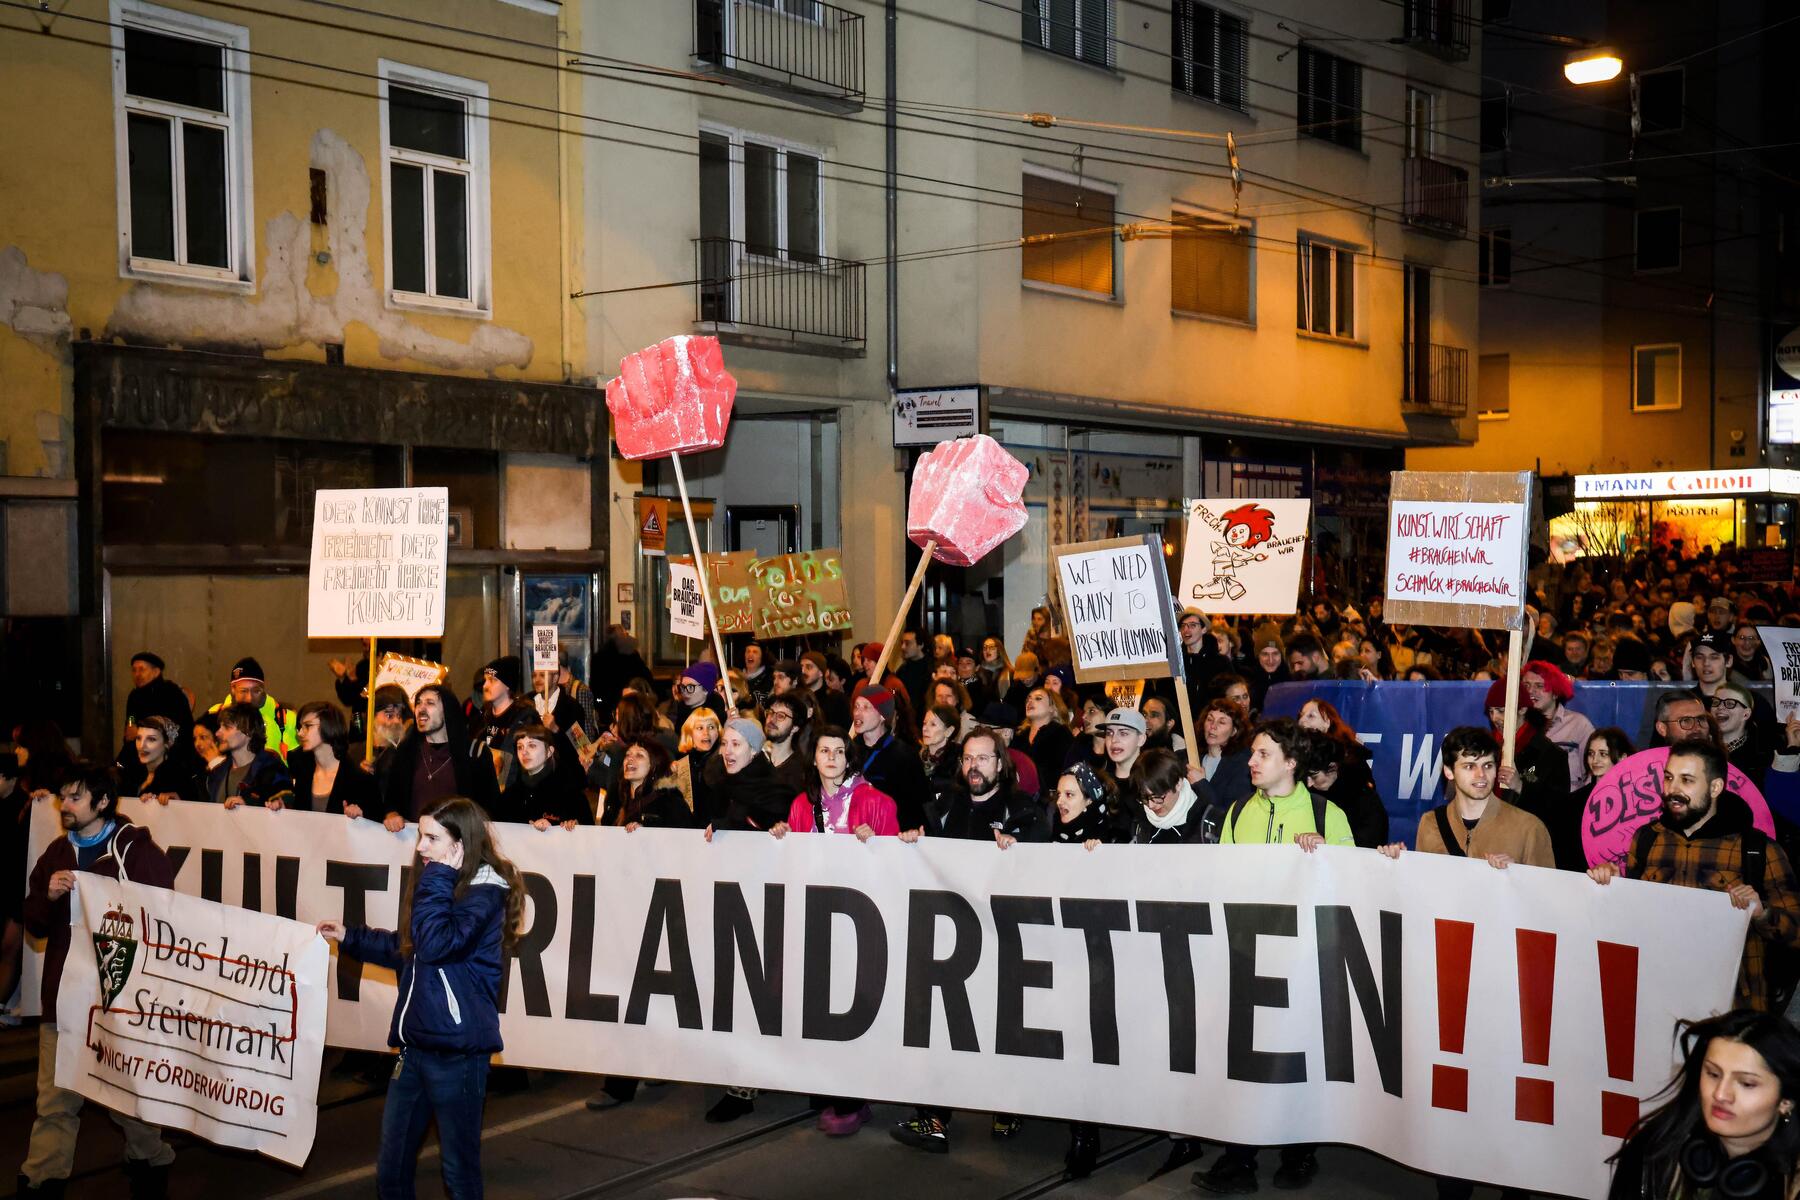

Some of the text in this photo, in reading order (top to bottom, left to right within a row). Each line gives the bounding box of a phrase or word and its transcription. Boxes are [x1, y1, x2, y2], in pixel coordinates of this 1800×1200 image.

[323, 500, 356, 524] DER
[362, 496, 412, 525] KUNST
[402, 533, 438, 559] DER
[1278, 546, 1294, 555] WIR
[1068, 553, 1147, 585] WE NEED
[1395, 571, 1444, 595] SCHMUCK
[347, 590, 434, 626] KUNST!
[673, 588, 702, 607] BRAUCHEN
[681, 602, 695, 618] WIR!
[1072, 587, 1146, 624] BEAUTY TO
[153, 918, 289, 997] Das Land
[165, 846, 1640, 1140] TRLANDRETTEN!!!
[127, 988, 287, 1064] Steiermark
[104, 1048, 285, 1116] NICHT FÖRDERWÜRDIG
